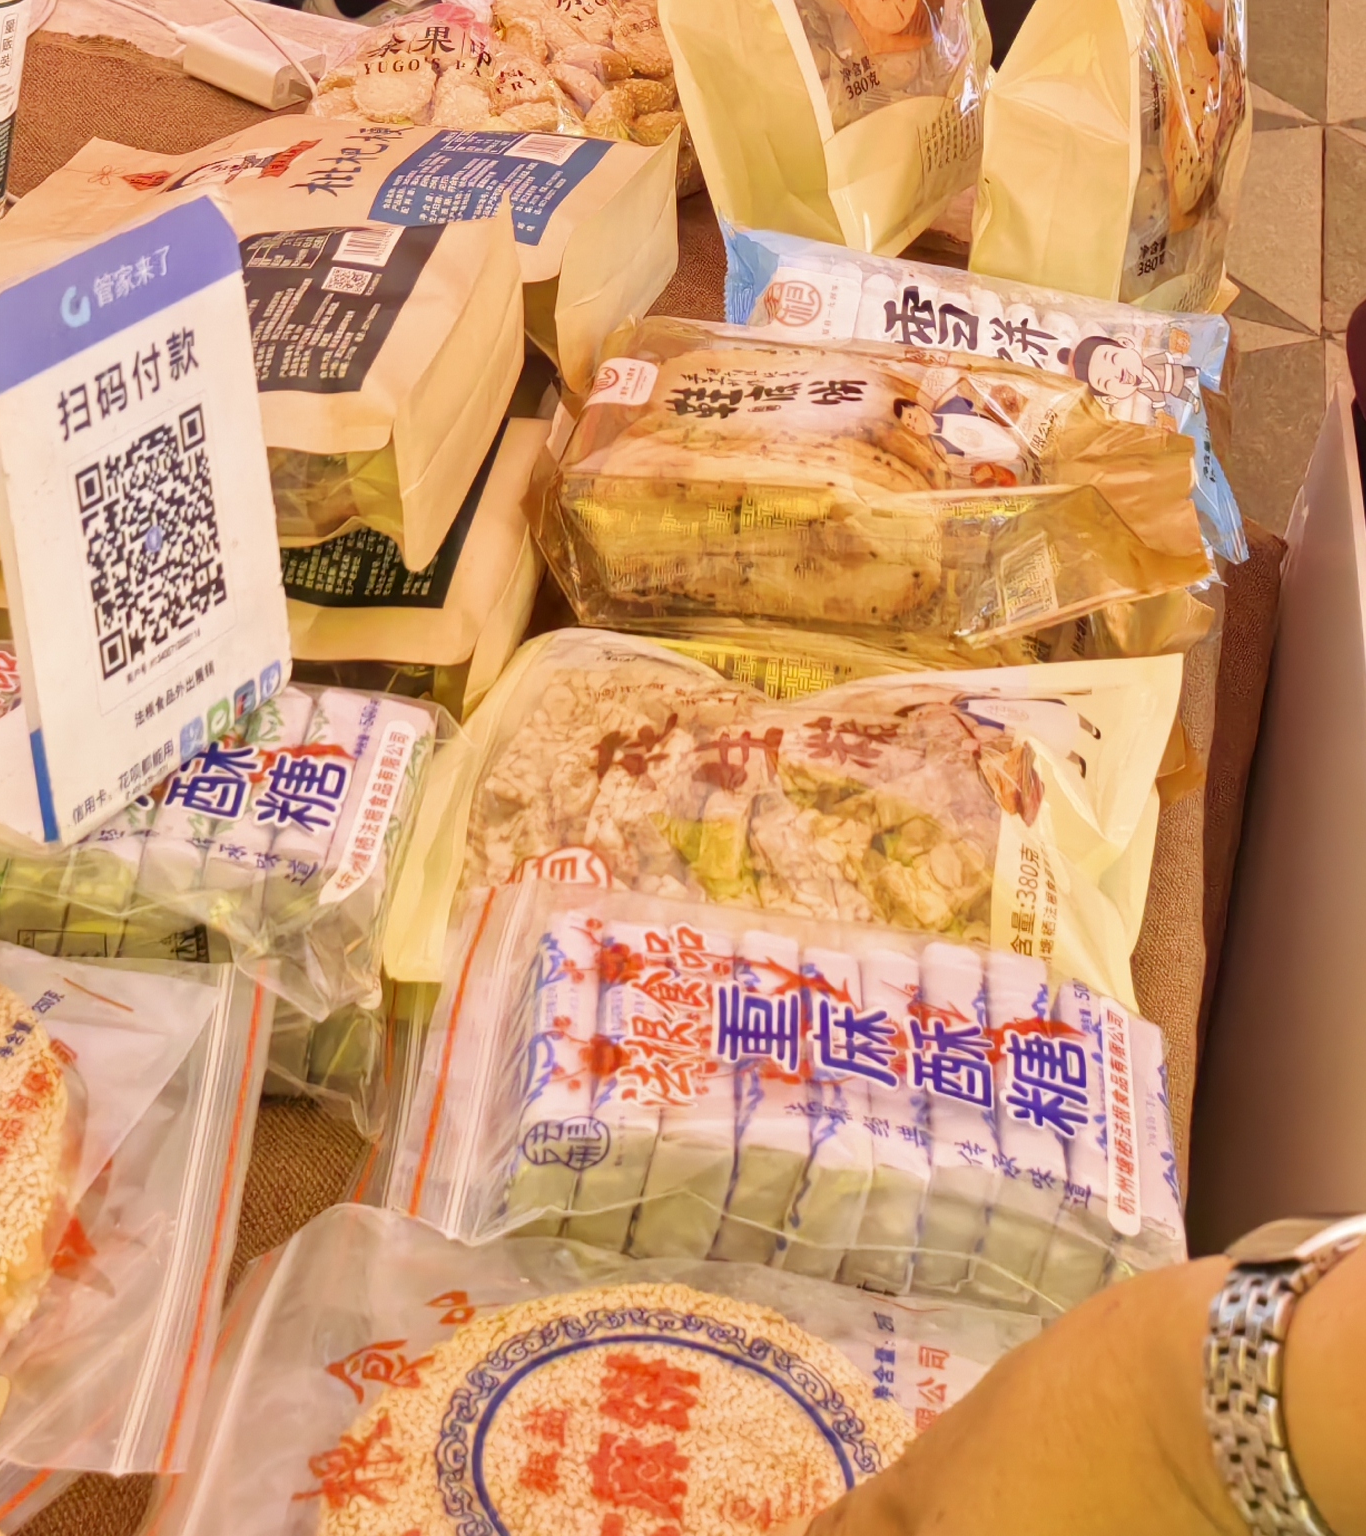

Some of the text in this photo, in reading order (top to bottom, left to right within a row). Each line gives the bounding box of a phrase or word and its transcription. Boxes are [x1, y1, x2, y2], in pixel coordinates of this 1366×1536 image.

[845, 70, 881, 100] 380克
[92, 244, 171, 308] 管家来了
[56, 326, 200, 443] 扫码付款
[619, 924, 709, 1107] 法根食品
[712, 980, 1093, 1138] 重麻酥糖
